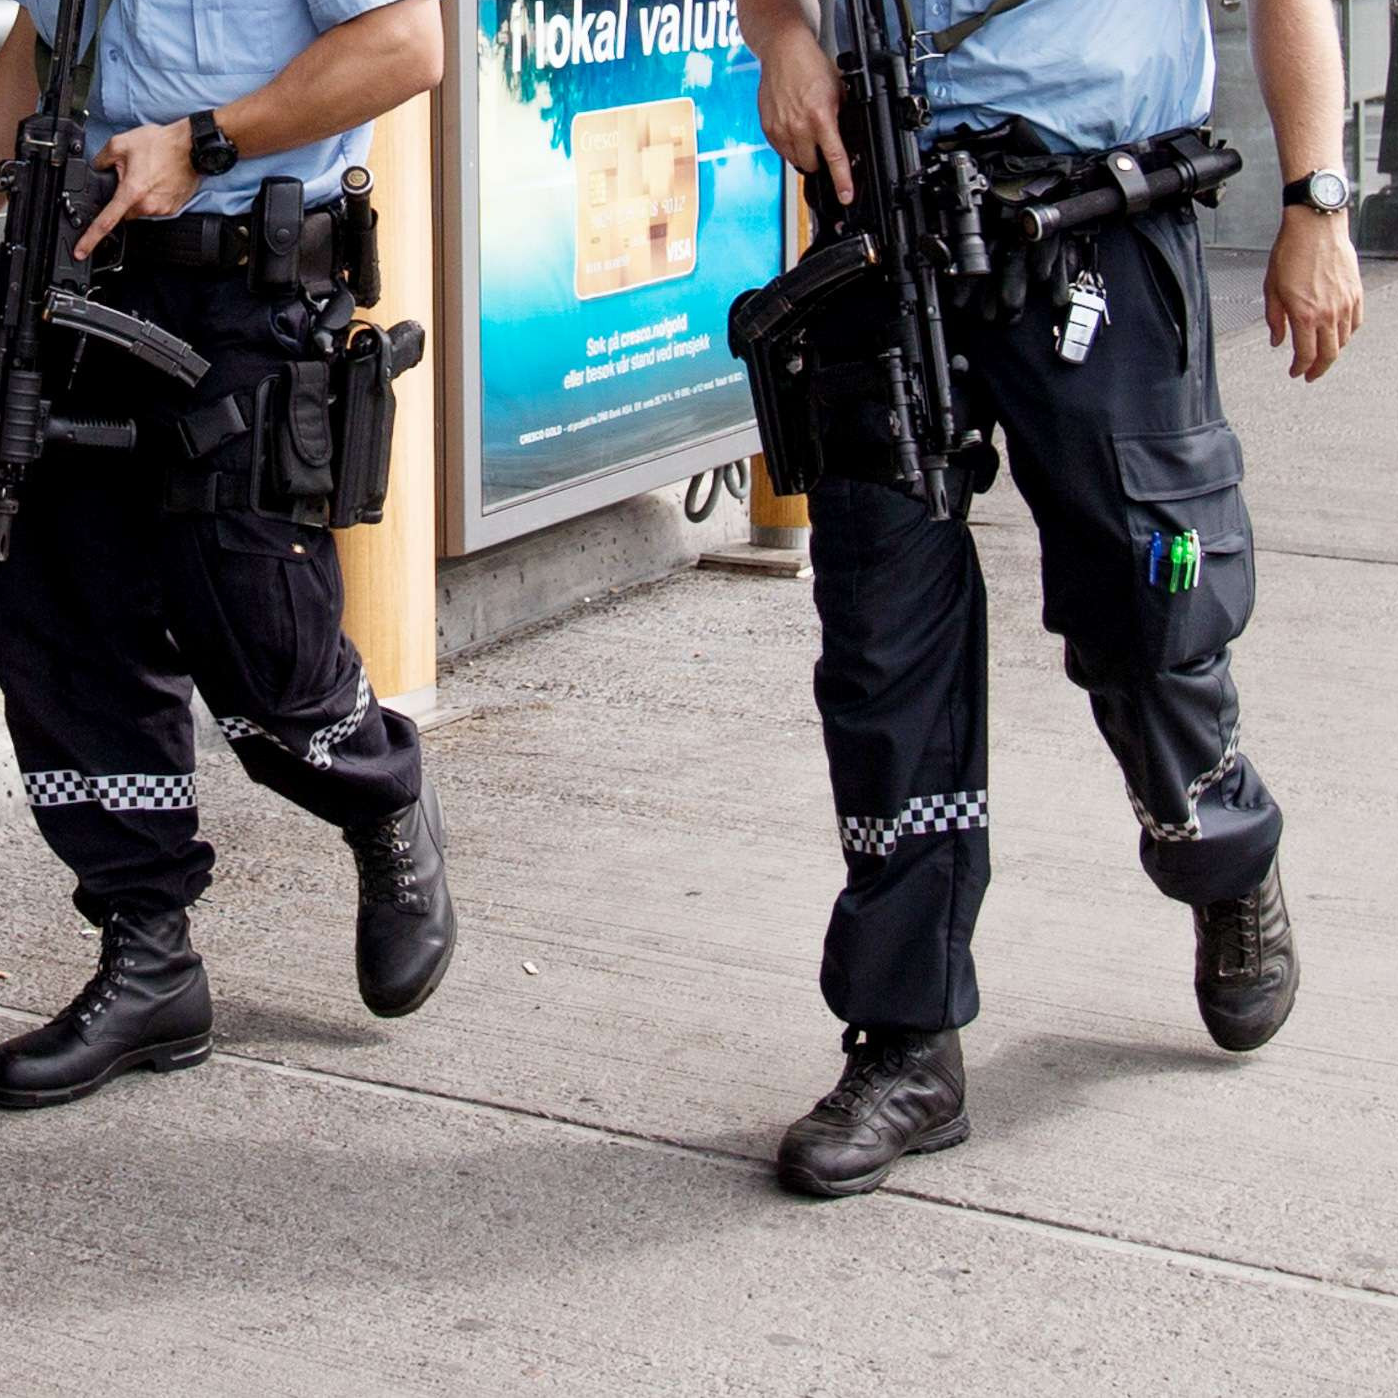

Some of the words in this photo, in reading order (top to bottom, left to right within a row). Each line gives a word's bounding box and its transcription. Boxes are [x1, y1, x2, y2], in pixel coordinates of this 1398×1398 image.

[667, 238, 692, 263] VISA
[586, 336, 607, 357] Søk
[564, 369, 585, 389] eller
[630, 348, 655, 371] stand
[656, 343, 673, 362] ved
